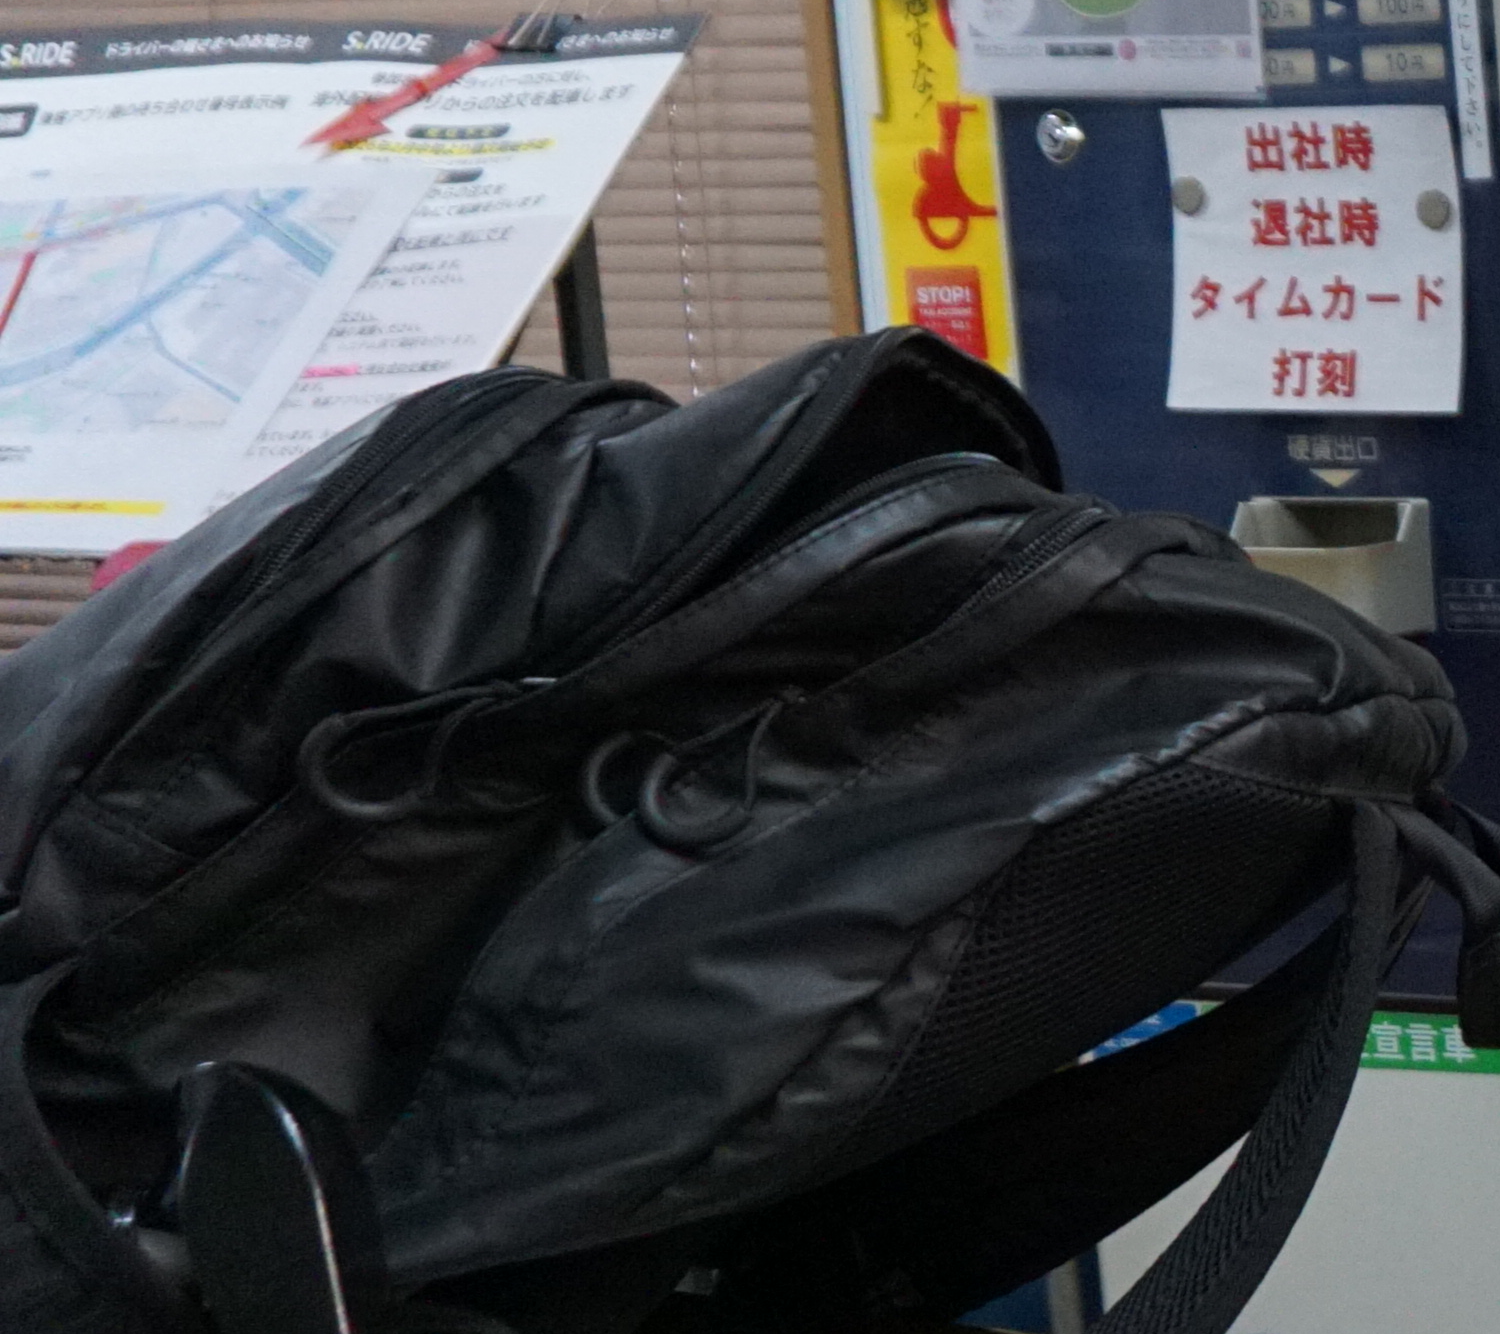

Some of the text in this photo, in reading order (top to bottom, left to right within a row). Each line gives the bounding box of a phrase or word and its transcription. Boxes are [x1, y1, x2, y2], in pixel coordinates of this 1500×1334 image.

[342, 30, 432, 55] S.RIDE
[1244, 120, 1375, 172] 出社時
[1250, 196, 1380, 248] 退社時
[916, 284, 972, 304] STOP!
[1189, 273, 1446, 322] タイムカード
[1271, 347, 1358, 398] 打刻
